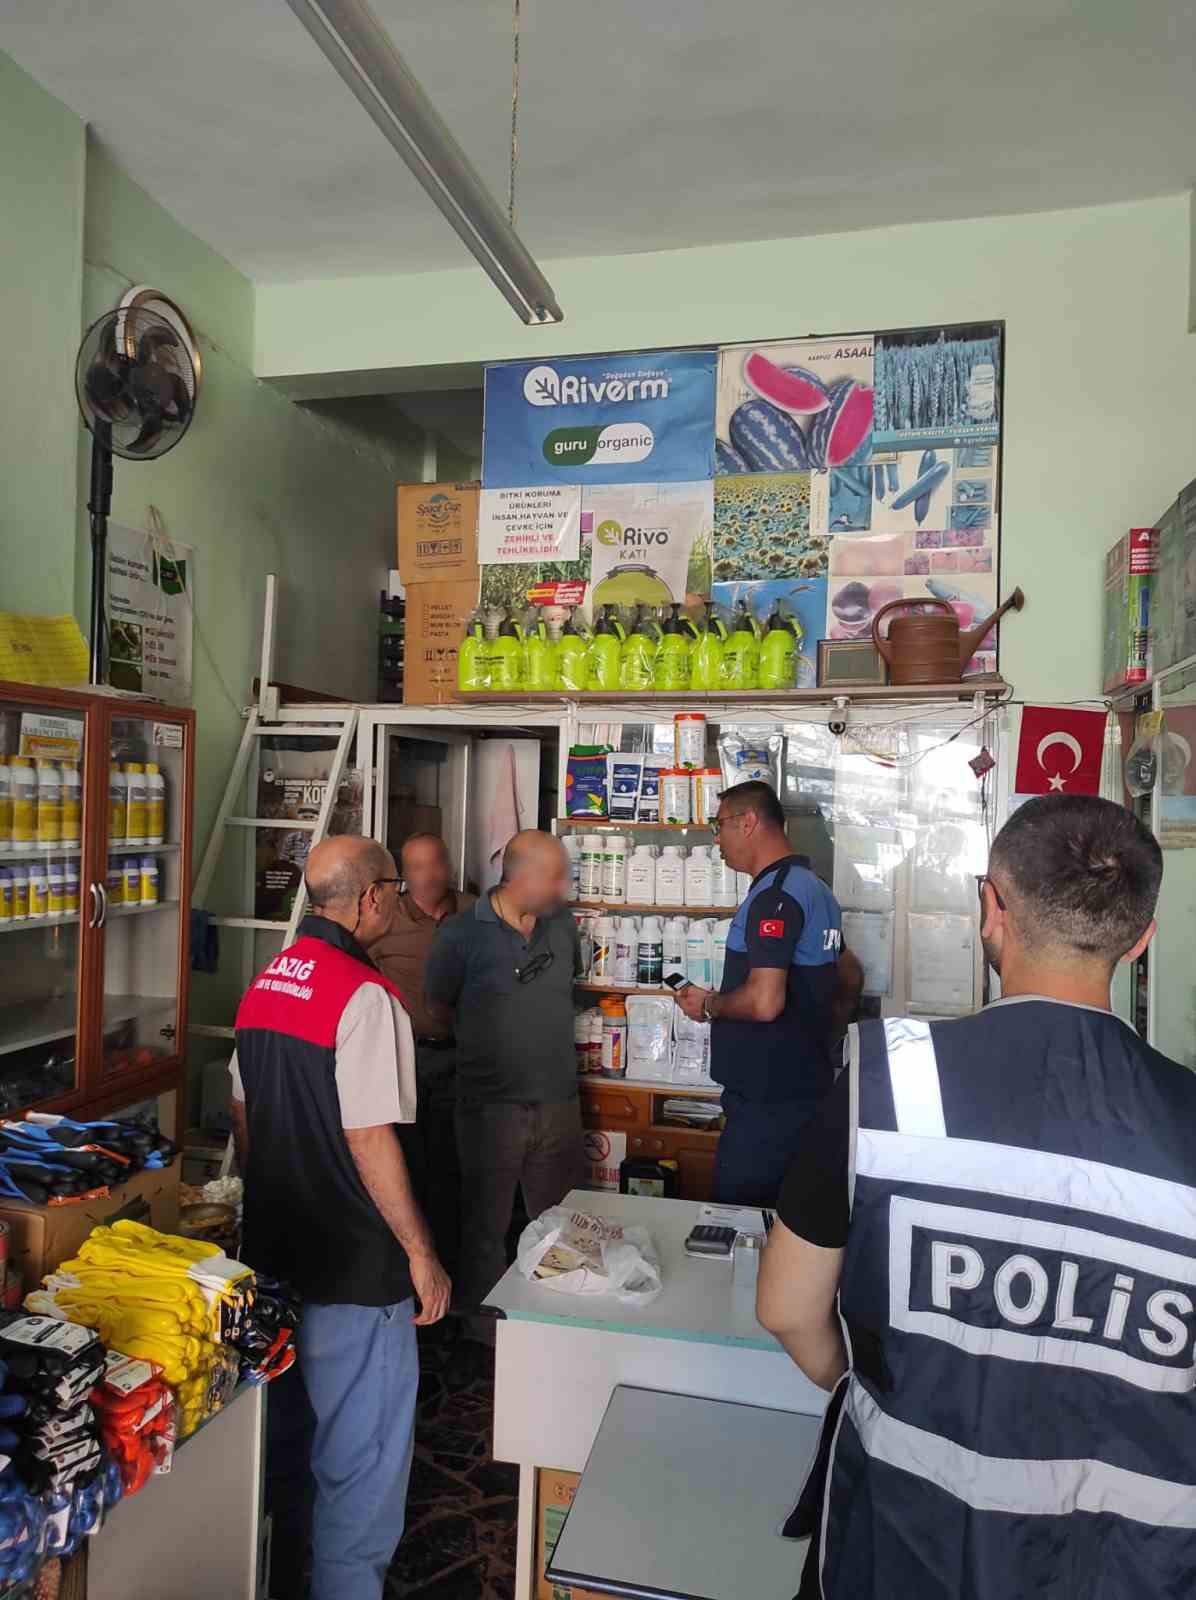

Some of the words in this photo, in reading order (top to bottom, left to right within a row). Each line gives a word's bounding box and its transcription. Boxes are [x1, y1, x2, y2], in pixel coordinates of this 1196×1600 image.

[562, 376, 669, 405] Riverm
[554, 438, 587, 454] guru
[598, 435, 652, 451] organic
[500, 491, 522, 499] BİTKİ
[524, 489, 561, 498] KORUMA
[505, 524, 533, 532] ÇEVRE
[535, 523, 553, 531] İÇİN
[624, 527, 669, 546] Rivo
